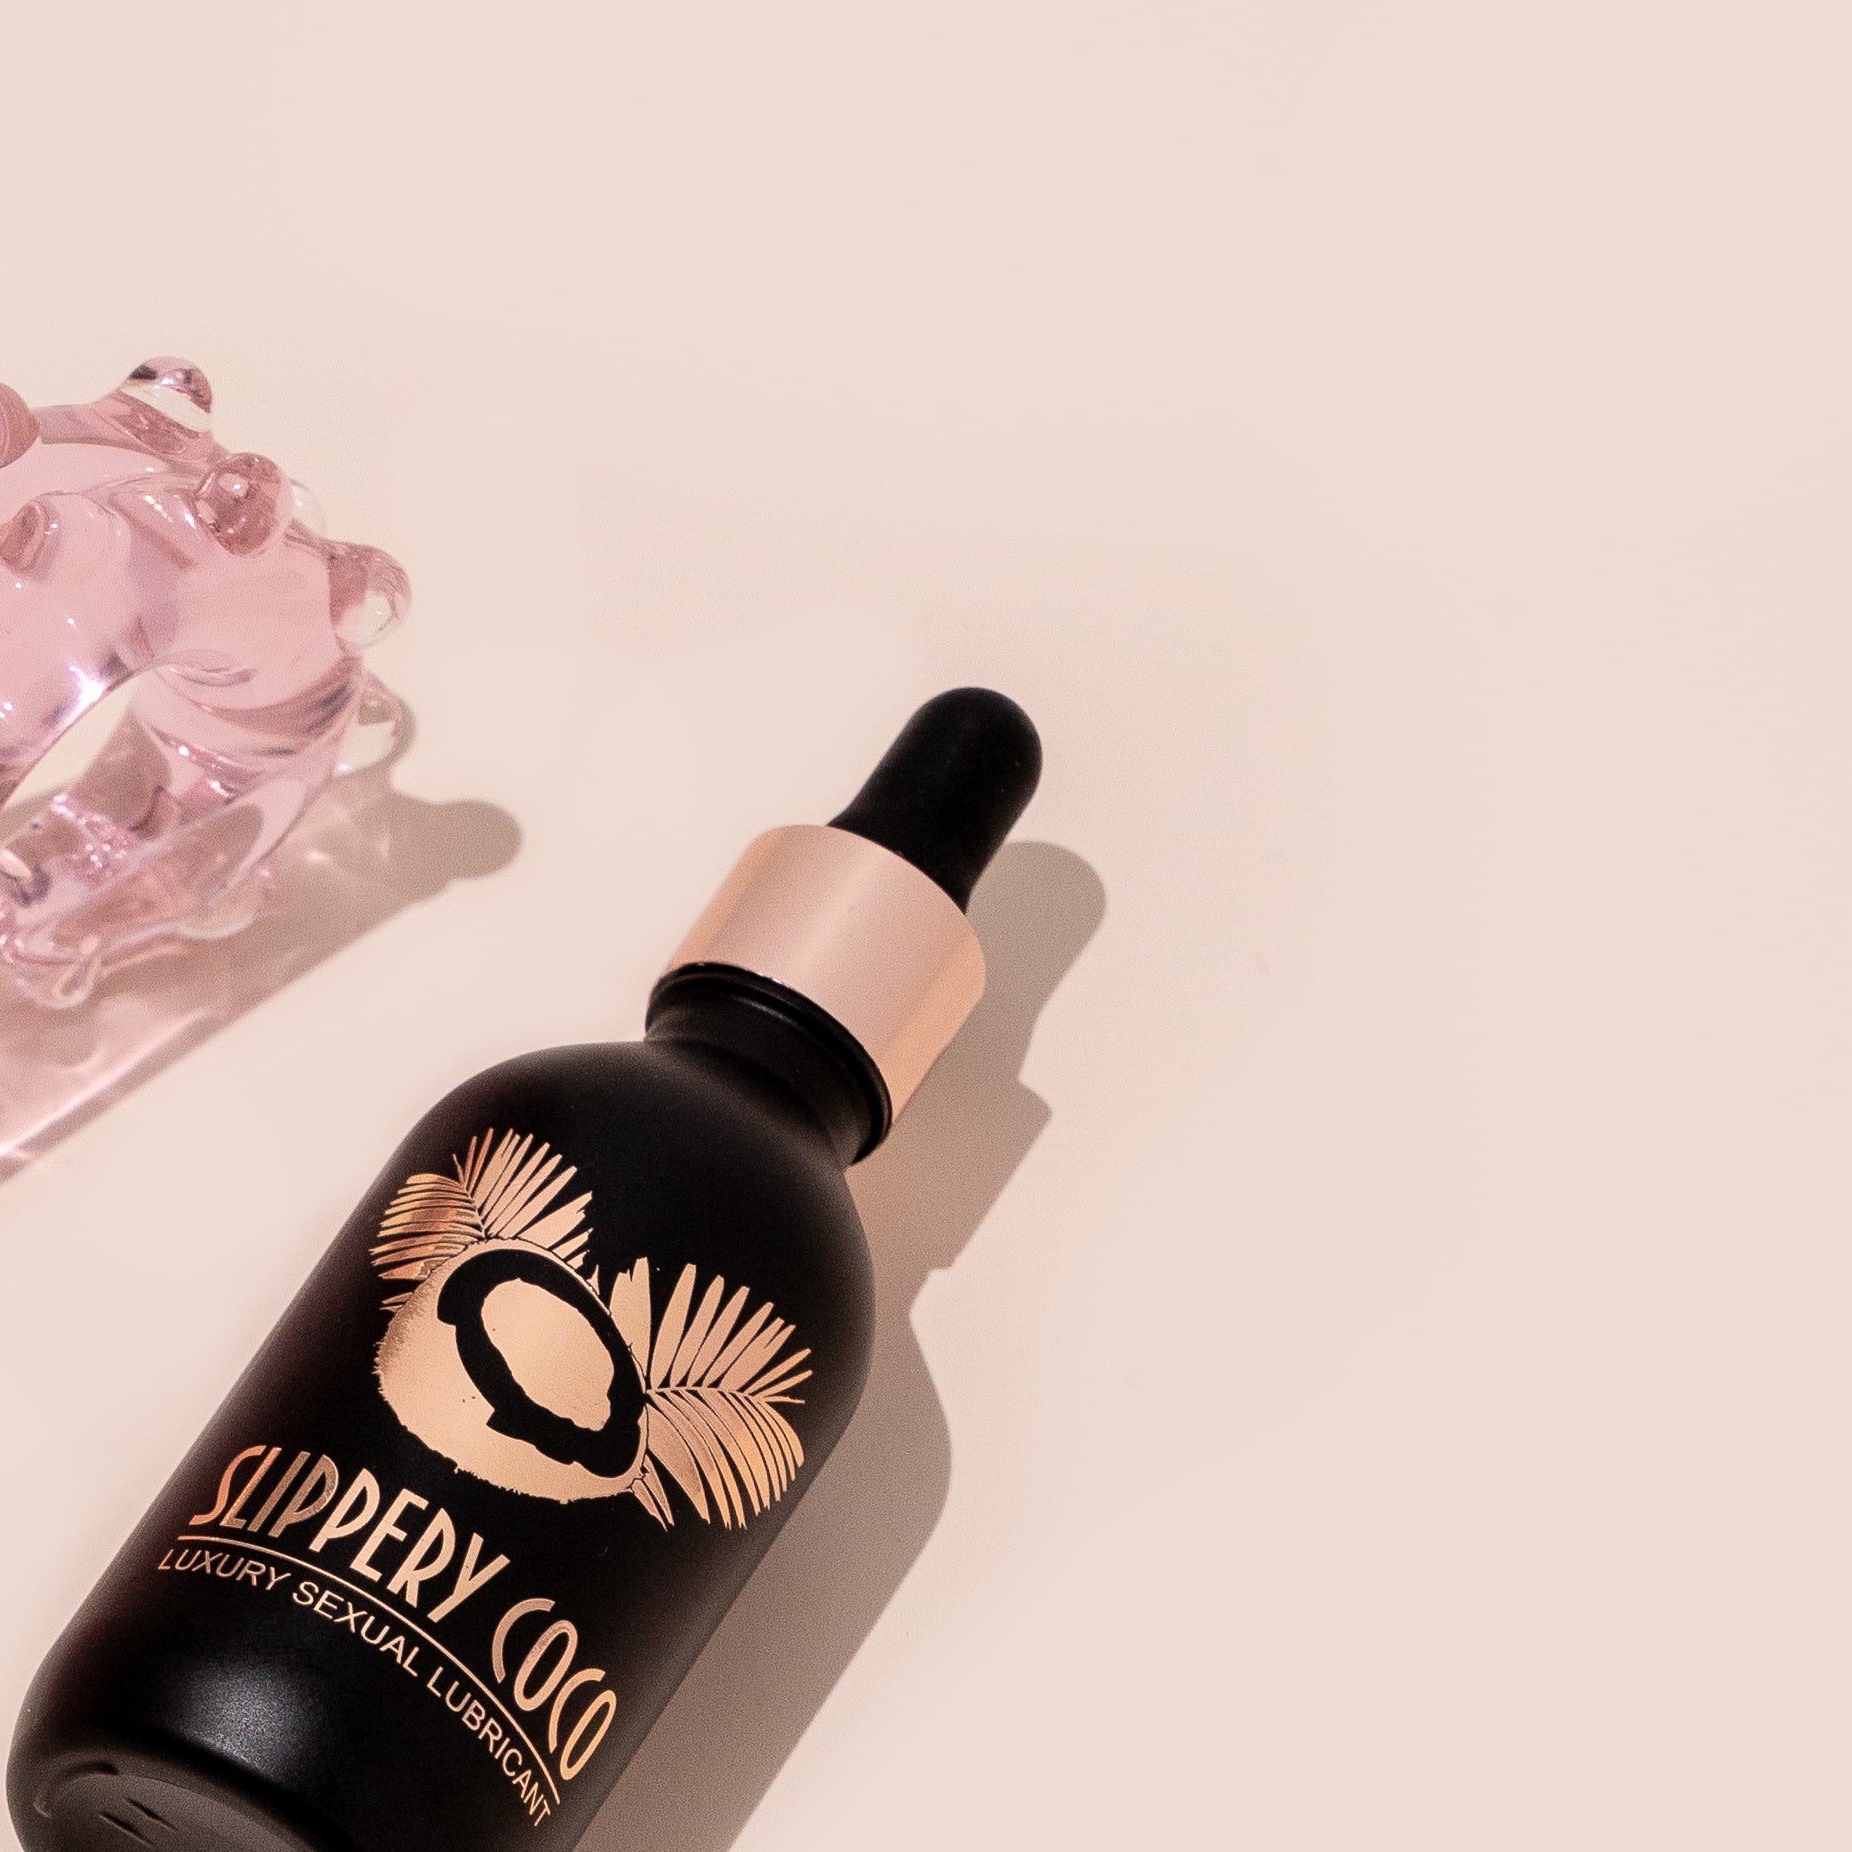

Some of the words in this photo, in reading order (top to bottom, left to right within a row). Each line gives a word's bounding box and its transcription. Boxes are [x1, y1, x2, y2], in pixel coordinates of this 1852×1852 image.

[157, 1548, 292, 1591] LUXURY
[291, 1580, 420, 1677] SEXUAL
[426, 1666, 552, 1828] LUBRICANT
[188, 1444, 511, 1624] SLIPPERY
[491, 1597, 618, 1781] COCO
